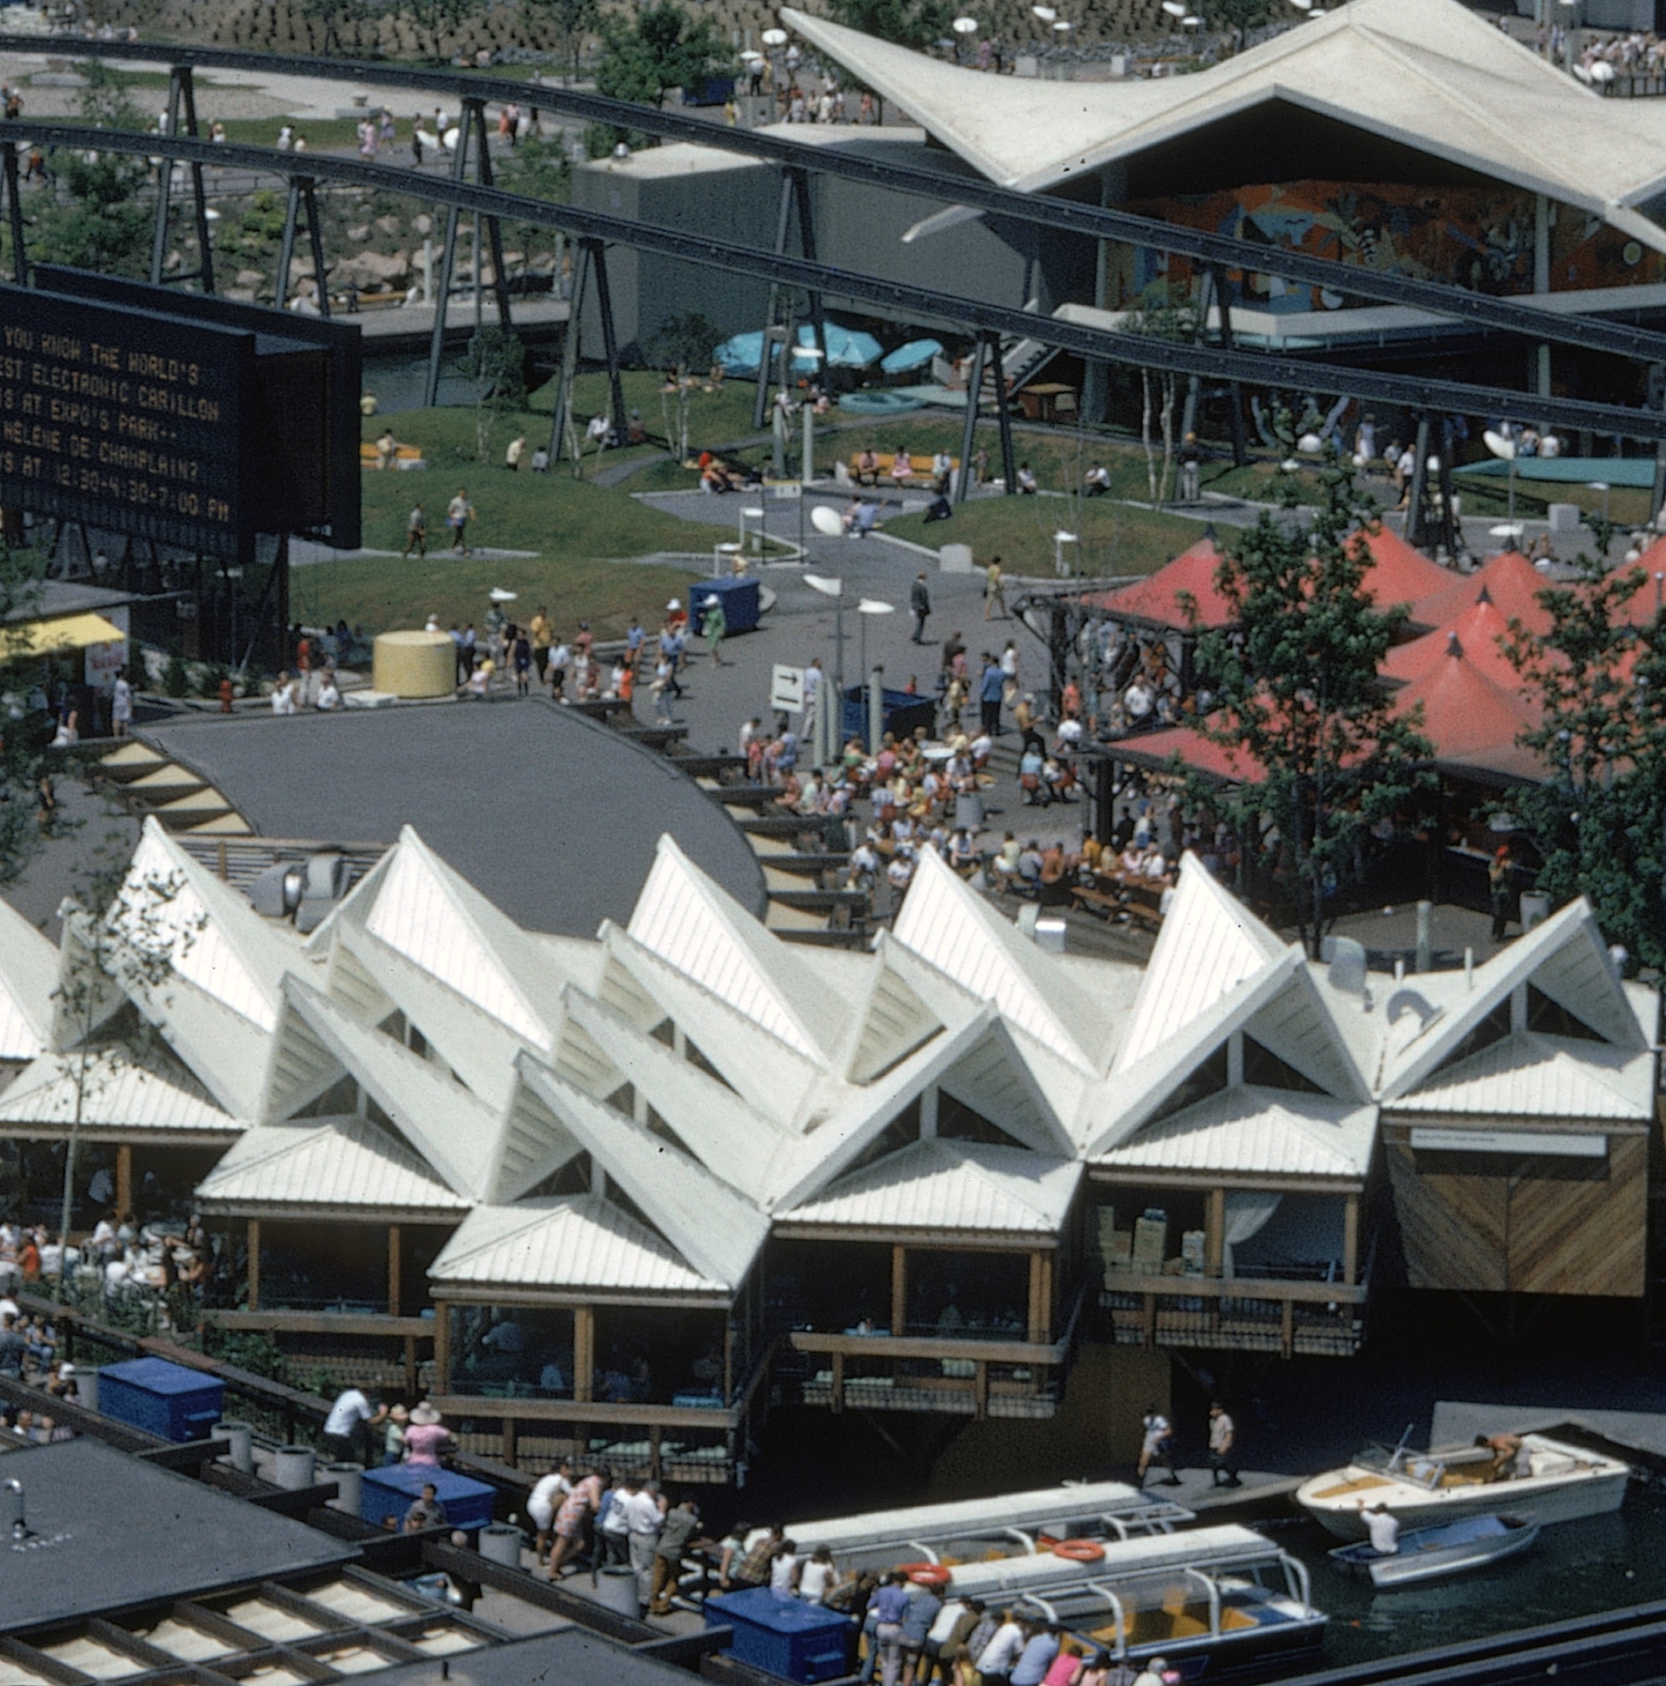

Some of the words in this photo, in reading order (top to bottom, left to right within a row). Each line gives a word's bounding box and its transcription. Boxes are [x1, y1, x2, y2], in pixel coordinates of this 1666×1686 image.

[4, 325, 34, 351] YOU
[41, 333, 81, 361] KNOW
[90, 342, 121, 370] THE
[128, 351, 199, 386] WORLD'S
[22, 393, 42, 416] AT
[50, 398, 110, 432] EXPO'S
[31, 362, 129, 404] ELECTRONIC
[138, 385, 220, 423] CARILLON
[3, 419, 62, 454] HELENE
[22, 455, 42, 478] AT
[207, 497, 230, 523] PM
